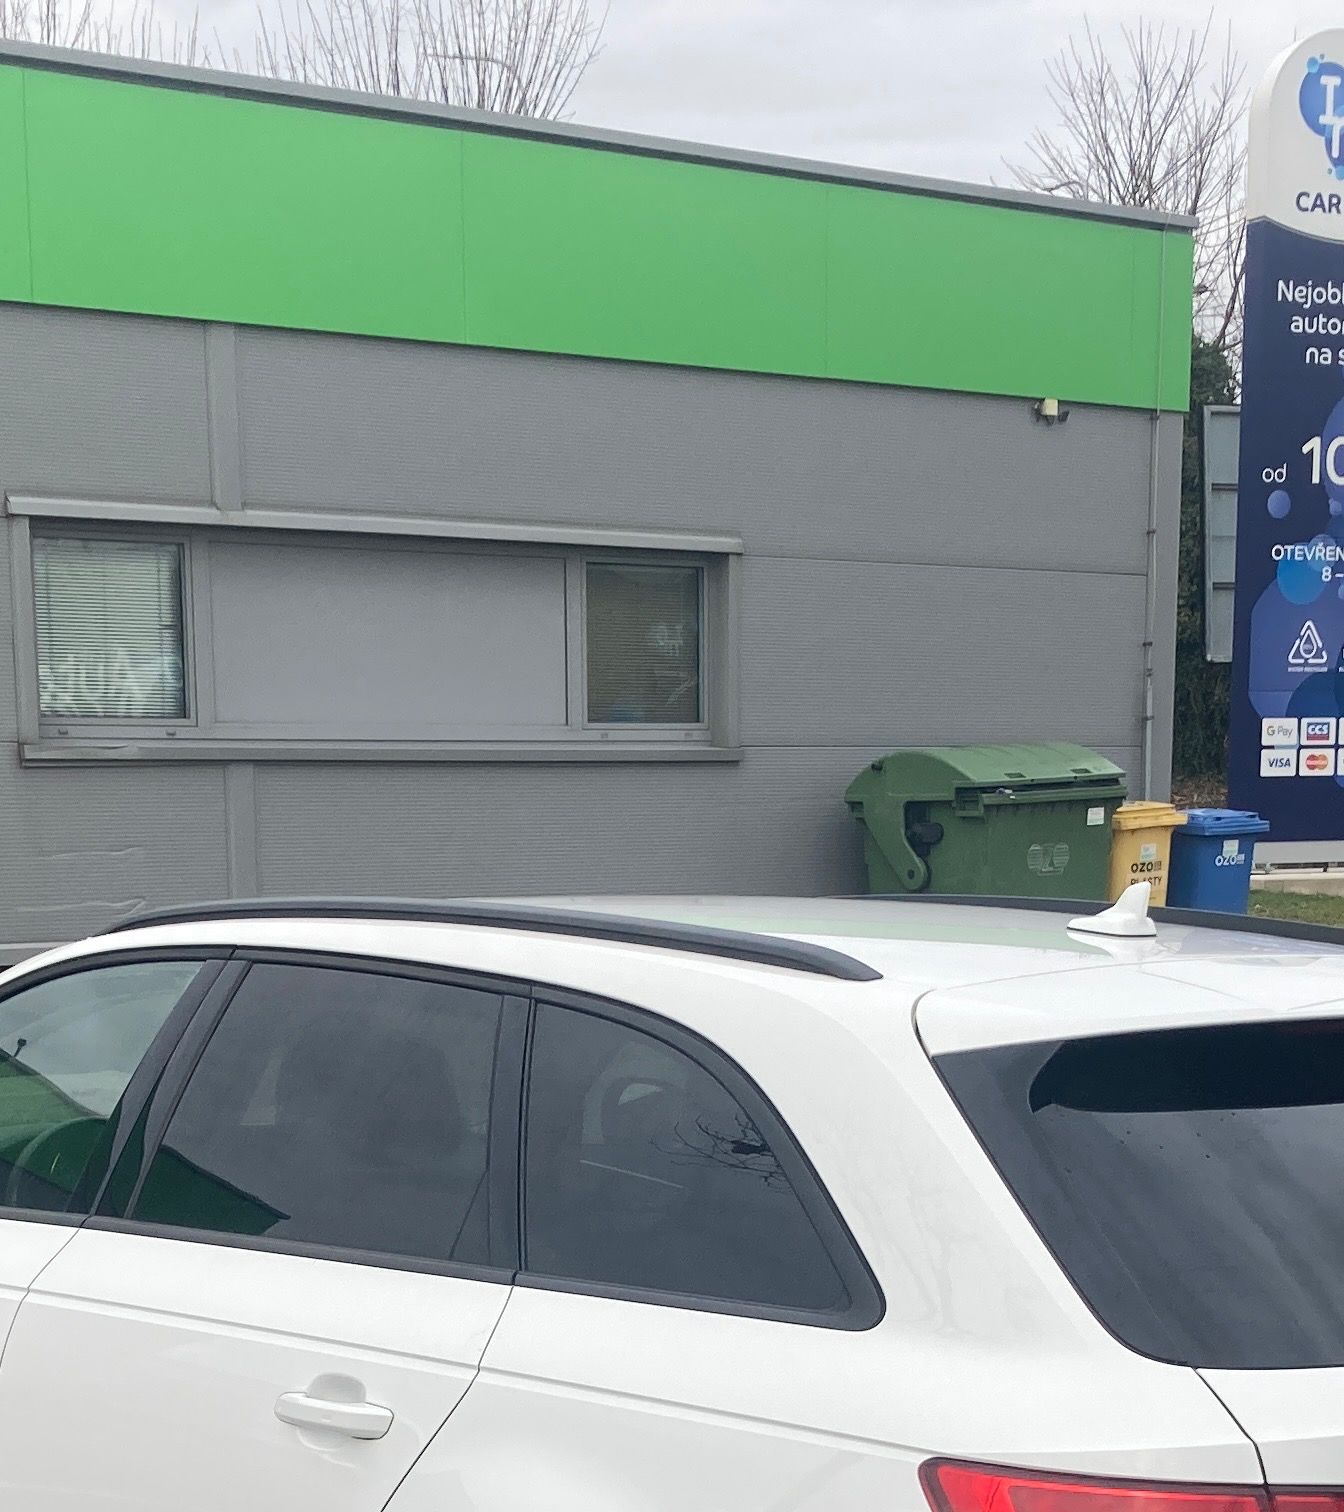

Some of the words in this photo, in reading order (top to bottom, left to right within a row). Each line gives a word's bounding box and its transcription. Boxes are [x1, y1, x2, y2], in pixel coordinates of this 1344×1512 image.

[1296, 191, 1341, 215] CAR
[1305, 347, 1333, 365] na
[1262, 463, 1287, 483] od
[1268, 757, 1291, 768] VISA
